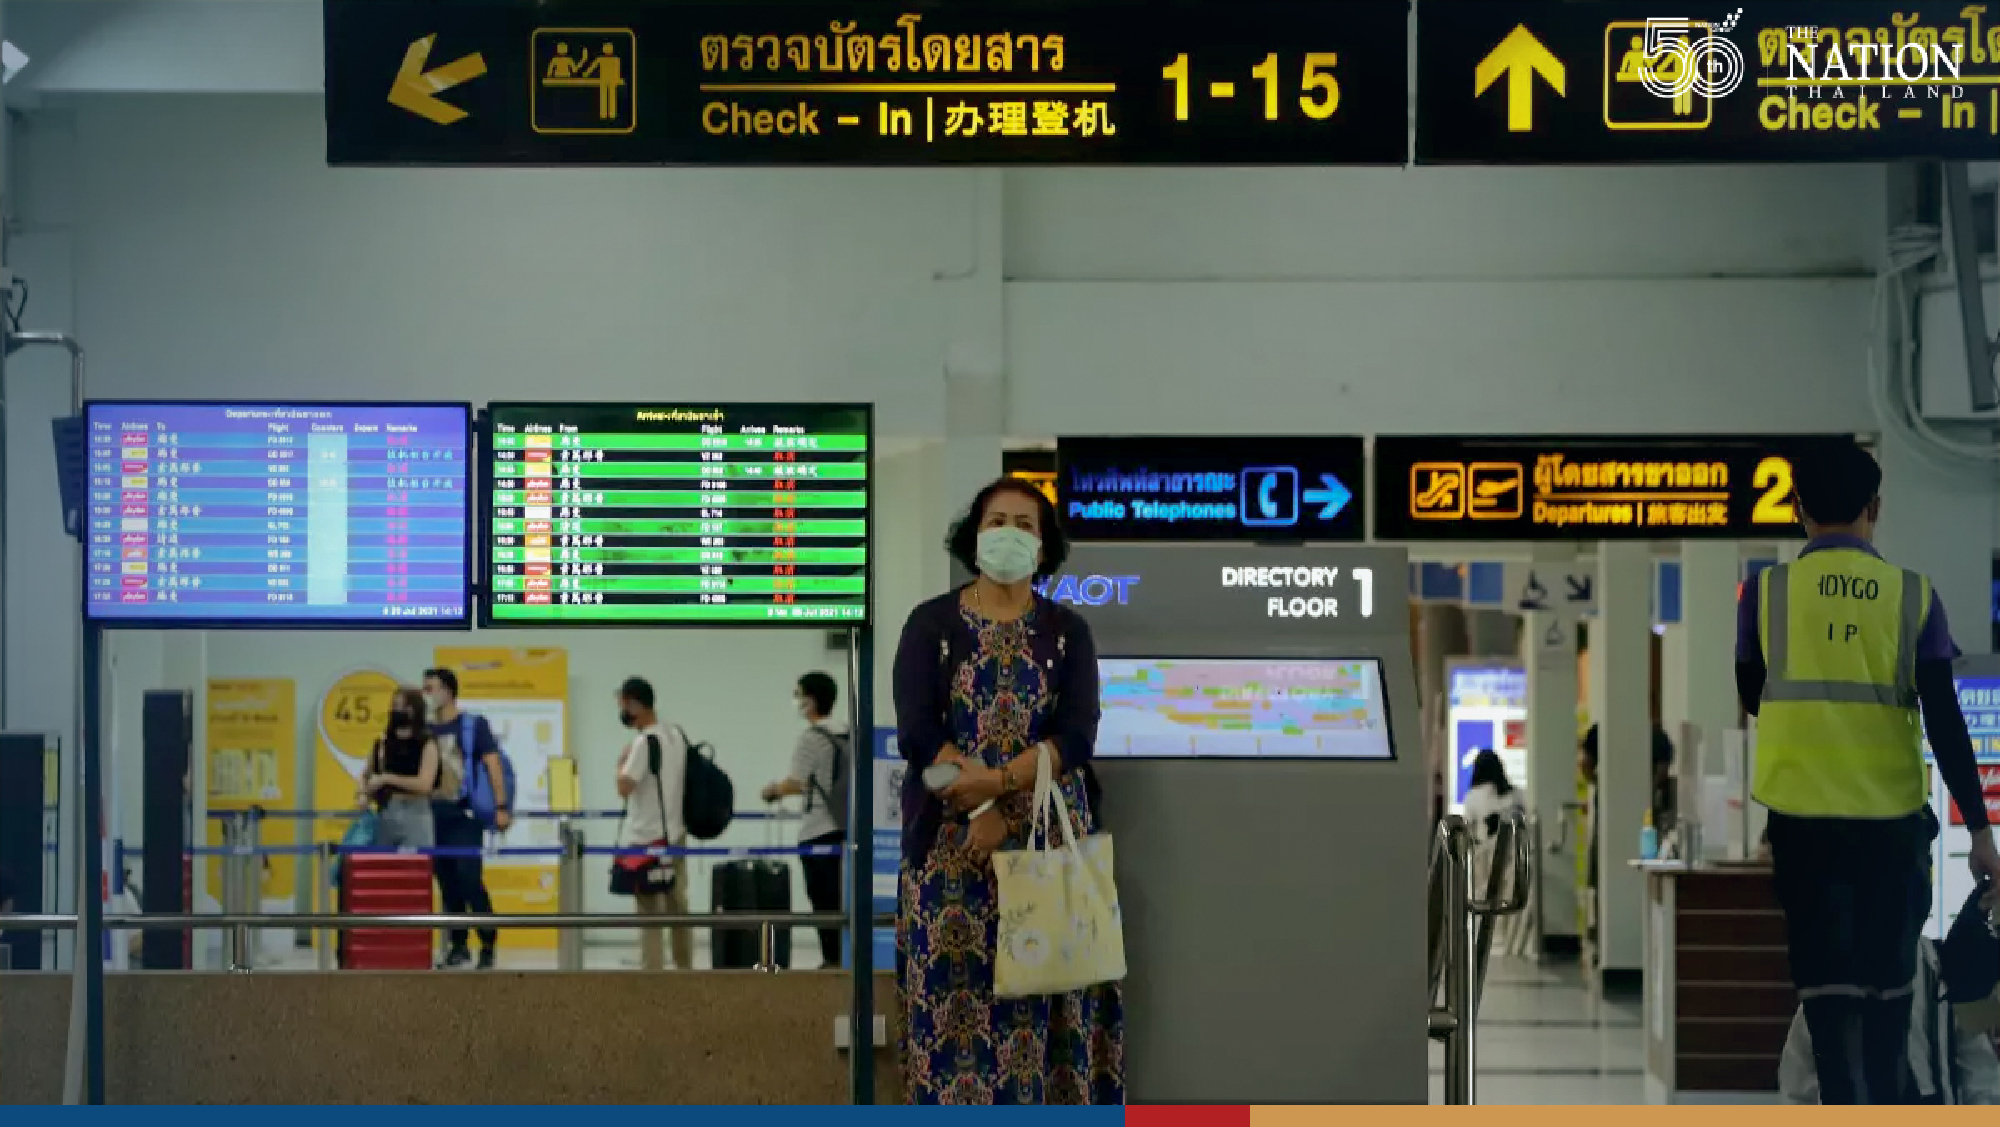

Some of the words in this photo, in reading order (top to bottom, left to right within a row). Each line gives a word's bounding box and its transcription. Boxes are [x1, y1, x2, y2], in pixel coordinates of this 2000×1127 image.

[701, 13, 1065, 72] ตรวจบัตรโดยสาร
[702, 101, 820, 136] Check
[945, 99, 1117, 138] 办理登机
[1758, 95, 1881, 131] Check
[1068, 500, 1126, 519] Public
[1131, 499, 1238, 523] Telephones
[1533, 501, 1633, 528] Departures
[1052, 574, 1142, 606] AOT
[1221, 566, 1339, 588] DIRECTORY
[1352, 568, 1374, 618] 1
[1267, 597, 1339, 618] FLOOR
